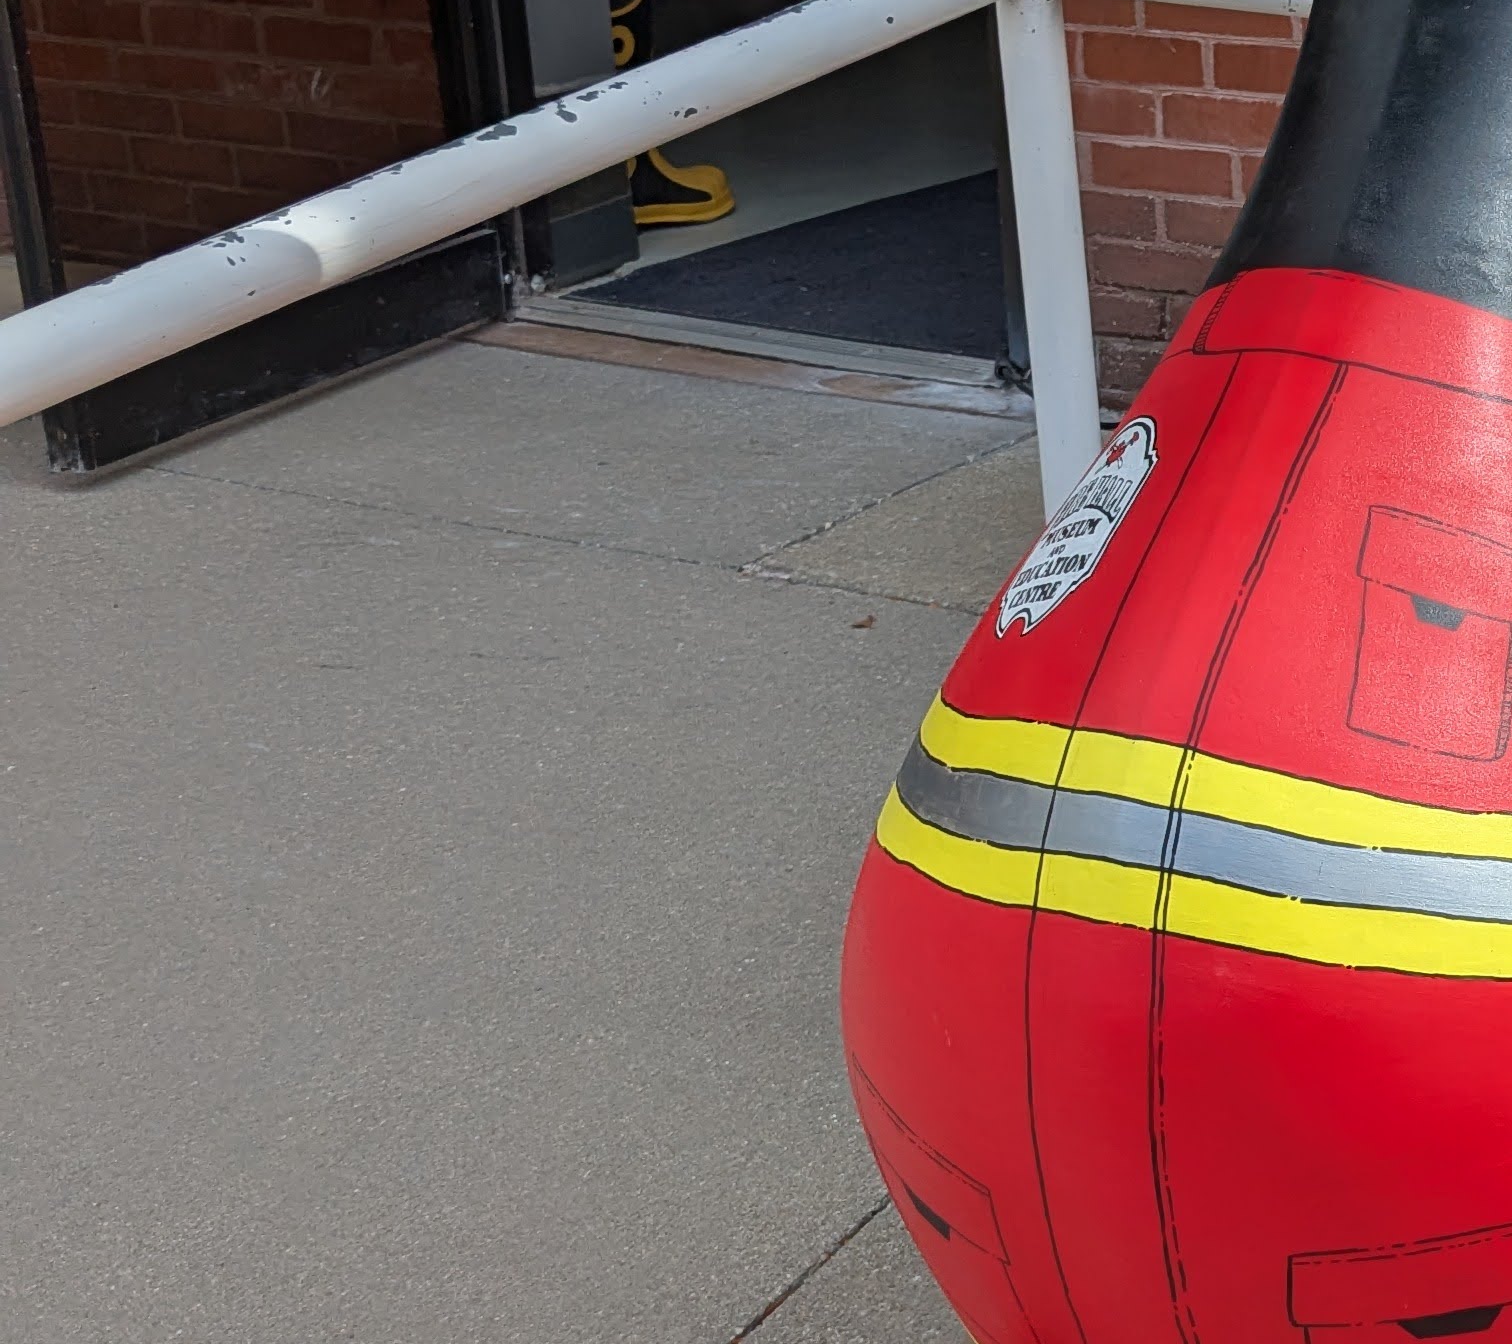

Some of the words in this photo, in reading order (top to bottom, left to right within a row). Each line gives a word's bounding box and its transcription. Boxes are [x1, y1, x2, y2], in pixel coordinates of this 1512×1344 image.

[1039, 517, 1103, 549] MUSEUM
[1012, 553, 1093, 590] EDUCATION
[1007, 580, 1063, 611] CENTRE
